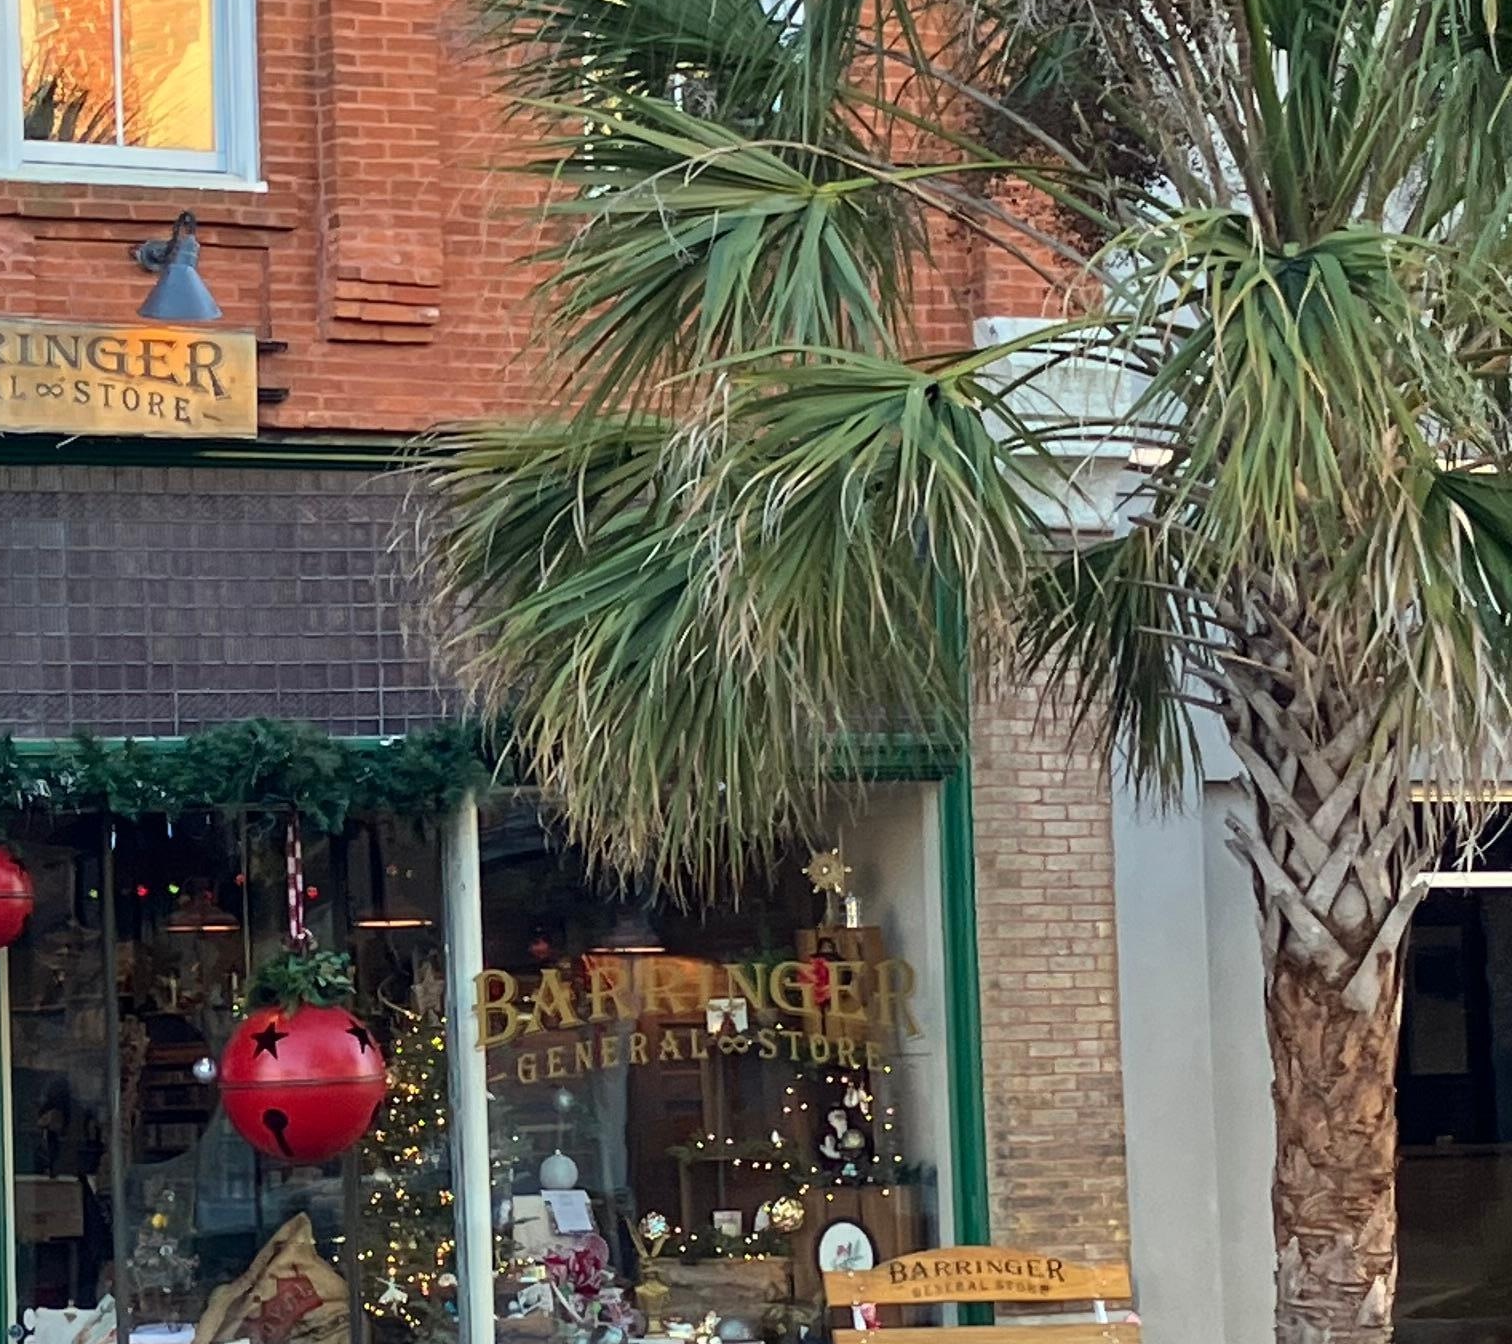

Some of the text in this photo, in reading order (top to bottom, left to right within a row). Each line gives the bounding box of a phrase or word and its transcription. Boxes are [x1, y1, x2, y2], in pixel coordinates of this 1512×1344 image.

[74, 380, 191, 424] STORE
[472, 958, 925, 1051] BARRINGER
[517, 1029, 884, 1084] GENERAL STORE
[889, 1257, 1065, 1284] BARRINGER
